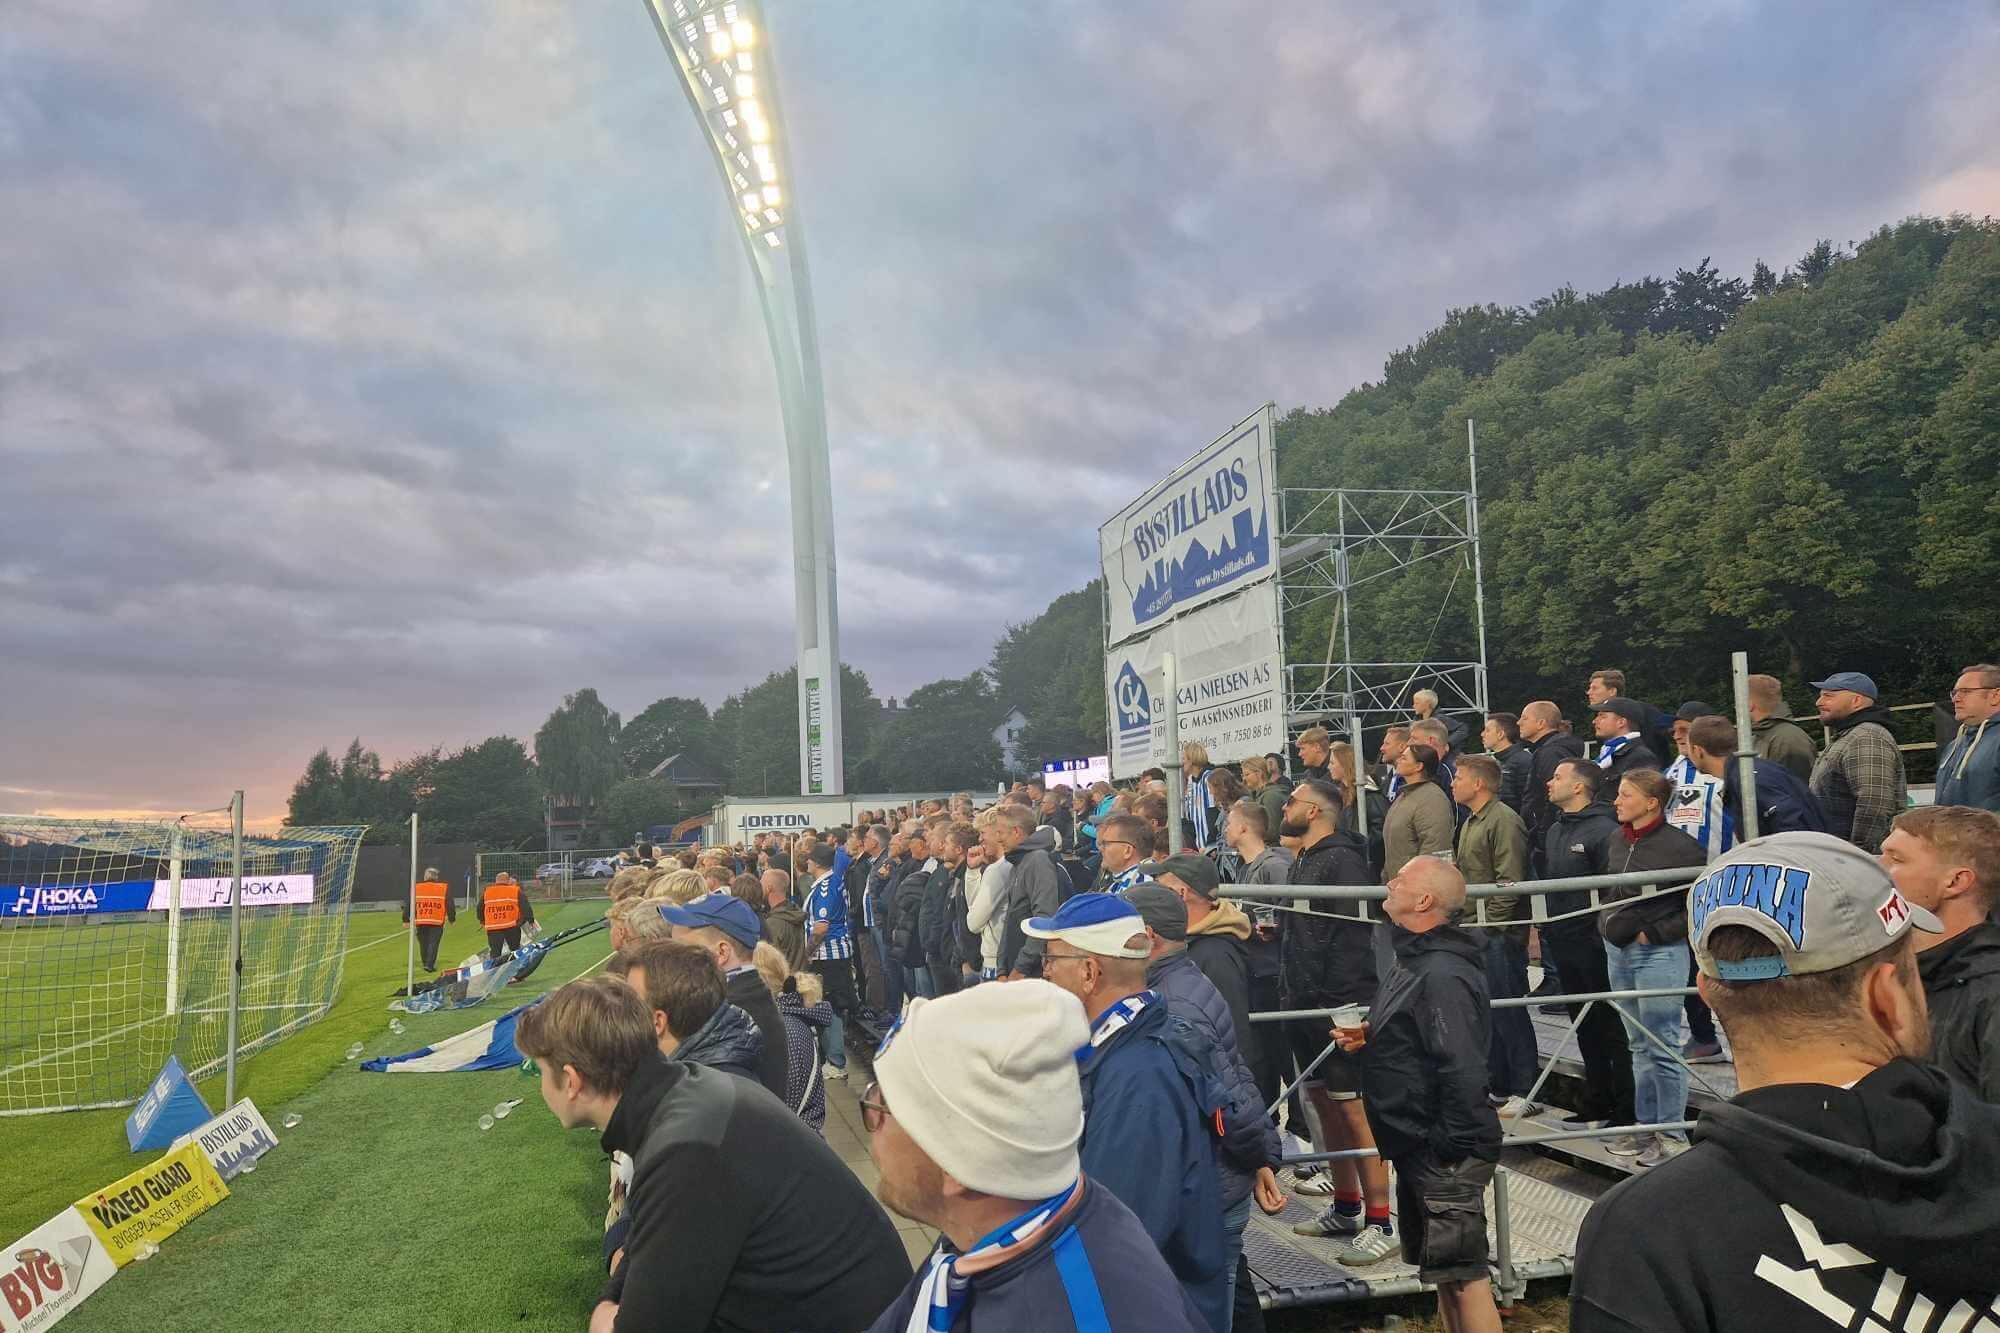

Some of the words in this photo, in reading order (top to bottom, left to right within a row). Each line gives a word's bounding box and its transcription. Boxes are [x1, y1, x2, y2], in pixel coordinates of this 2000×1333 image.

[1133, 457, 1248, 562] BYSTILLADS
[1201, 669, 1249, 699] NIELSEN
[1253, 662, 1271, 685] A/S
[1191, 697, 1273, 728] MASKINSNEDKERI
[1234, 727, 1251, 742] 7550
[1263, 724, 1272, 738] 66
[42, 887, 98, 905] HOKA
[241, 881, 288, 895] HOKA
[416, 901, 442, 910] TEWARD
[487, 905, 514, 913] TEWARD
[200, 1112, 254, 1154] BYSTILLADS
[92, 1185, 150, 1230] VIDEO
[144, 1160, 193, 1204] GUARD
[0, 1249, 64, 1321] BYG
